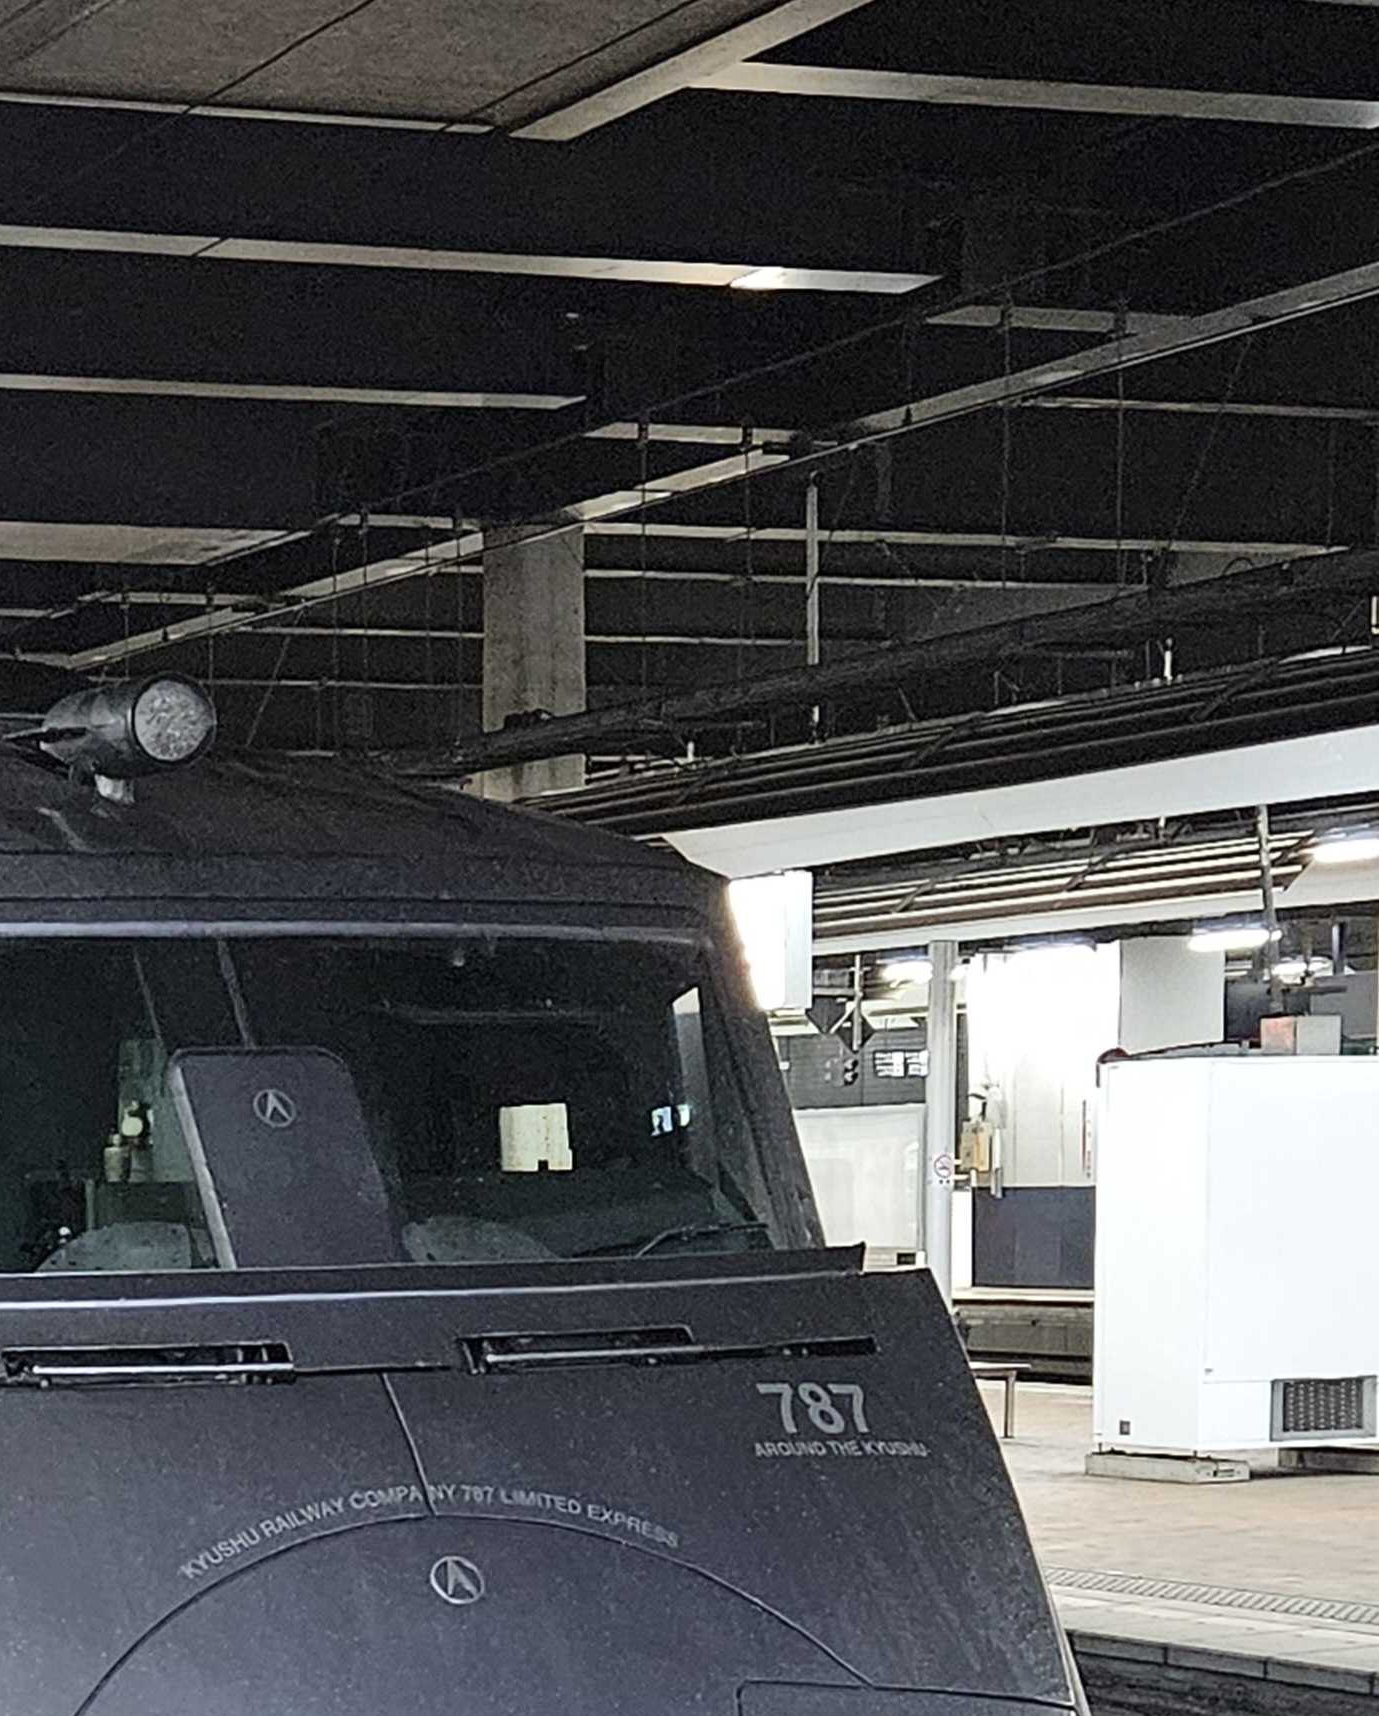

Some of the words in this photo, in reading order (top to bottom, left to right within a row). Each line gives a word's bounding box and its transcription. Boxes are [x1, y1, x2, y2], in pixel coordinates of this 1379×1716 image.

[756, 1382, 870, 1435] 787
[754, 1440, 827, 1457] AROUND
[826, 1439, 863, 1457] THE
[861, 1440, 929, 1458] KYUSHU
[180, 1527, 261, 1579] KYUSHU
[259, 1496, 346, 1538] RAILWAY
[460, 1484, 495, 1504] 787
[500, 1489, 581, 1515] LIMITED
[587, 1504, 679, 1548] EXPRESS
